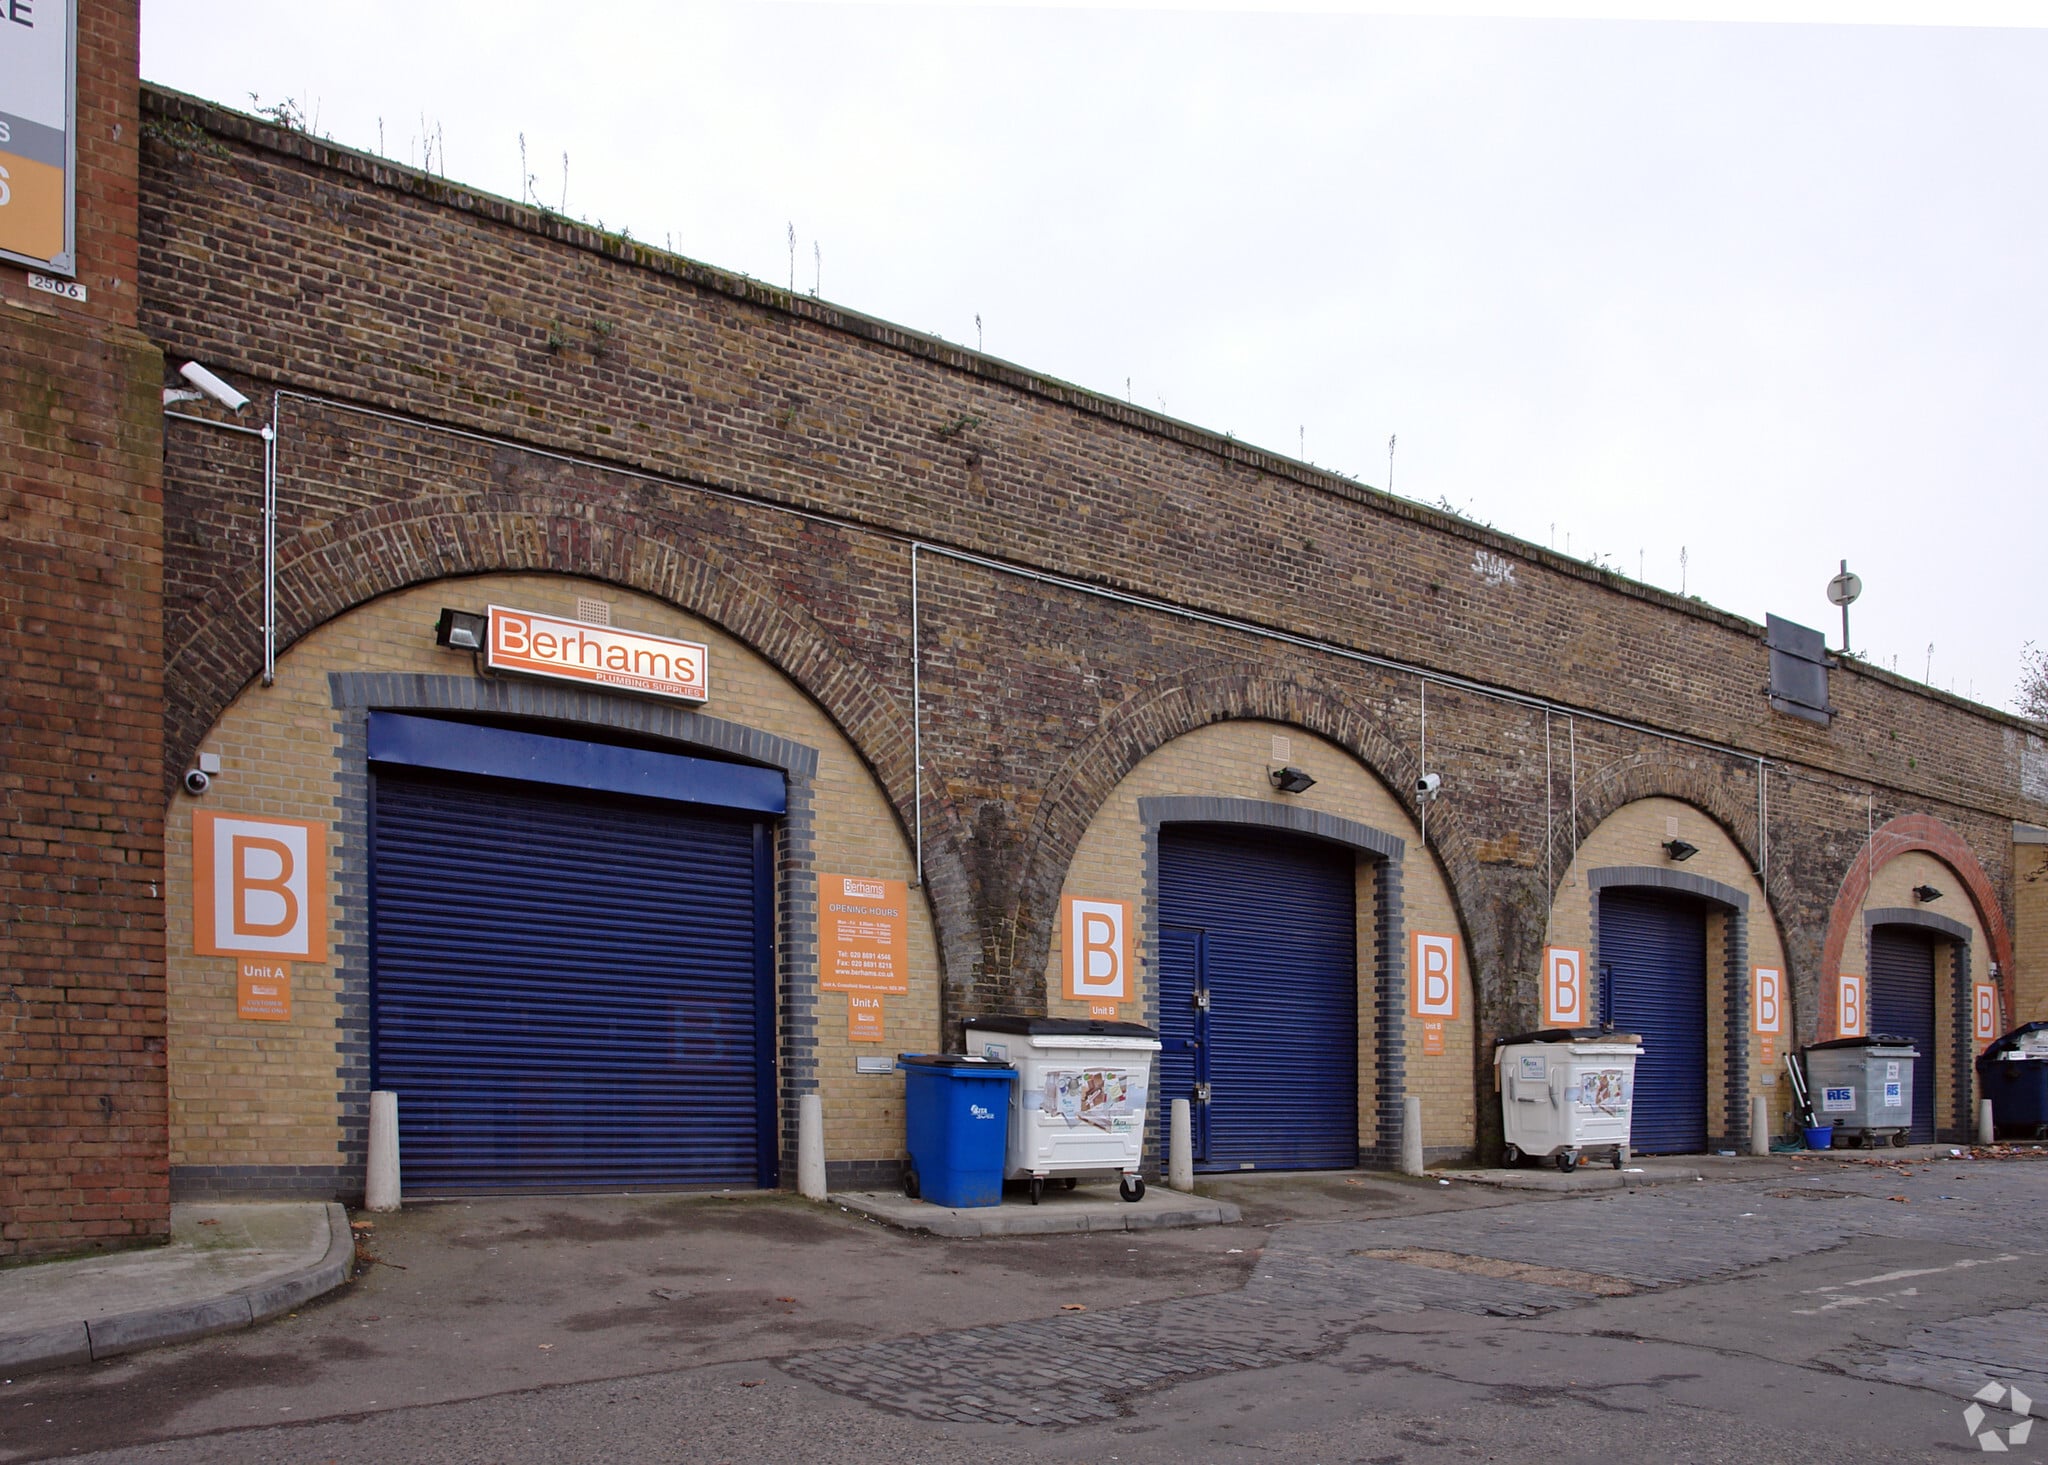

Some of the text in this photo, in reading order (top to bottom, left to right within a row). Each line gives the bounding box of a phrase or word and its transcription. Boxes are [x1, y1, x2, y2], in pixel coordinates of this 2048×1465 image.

[35, 276, 78, 297] 2506
[498, 616, 695, 683] Berhams
[595, 672, 701, 697] PLUMBING SUPPLIES
[232, 834, 299, 938] B
[845, 880, 883, 895] Berhams
[829, 903, 898, 917] OPENING HOURS
[850, 951, 861, 959] 020
[1082, 911, 1118, 986] B
[244, 964, 285, 979] Unit A
[851, 960, 863, 968] 020
[1424, 944, 1449, 1006] B
[1555, 957, 1577, 1014] B
[852, 998, 881, 1009] Unit A
[1761, 976, 1776, 1025] B
[1844, 983, 1858, 1029] B
[1092, 1006, 1115, 1015] Unit B
[1980, 992, 1991, 1032] B
[1425, 1022, 1436, 1030] Unit
[1827, 1088, 1851, 1100] RTS
[1887, 1084, 1899, 1096] RTS
